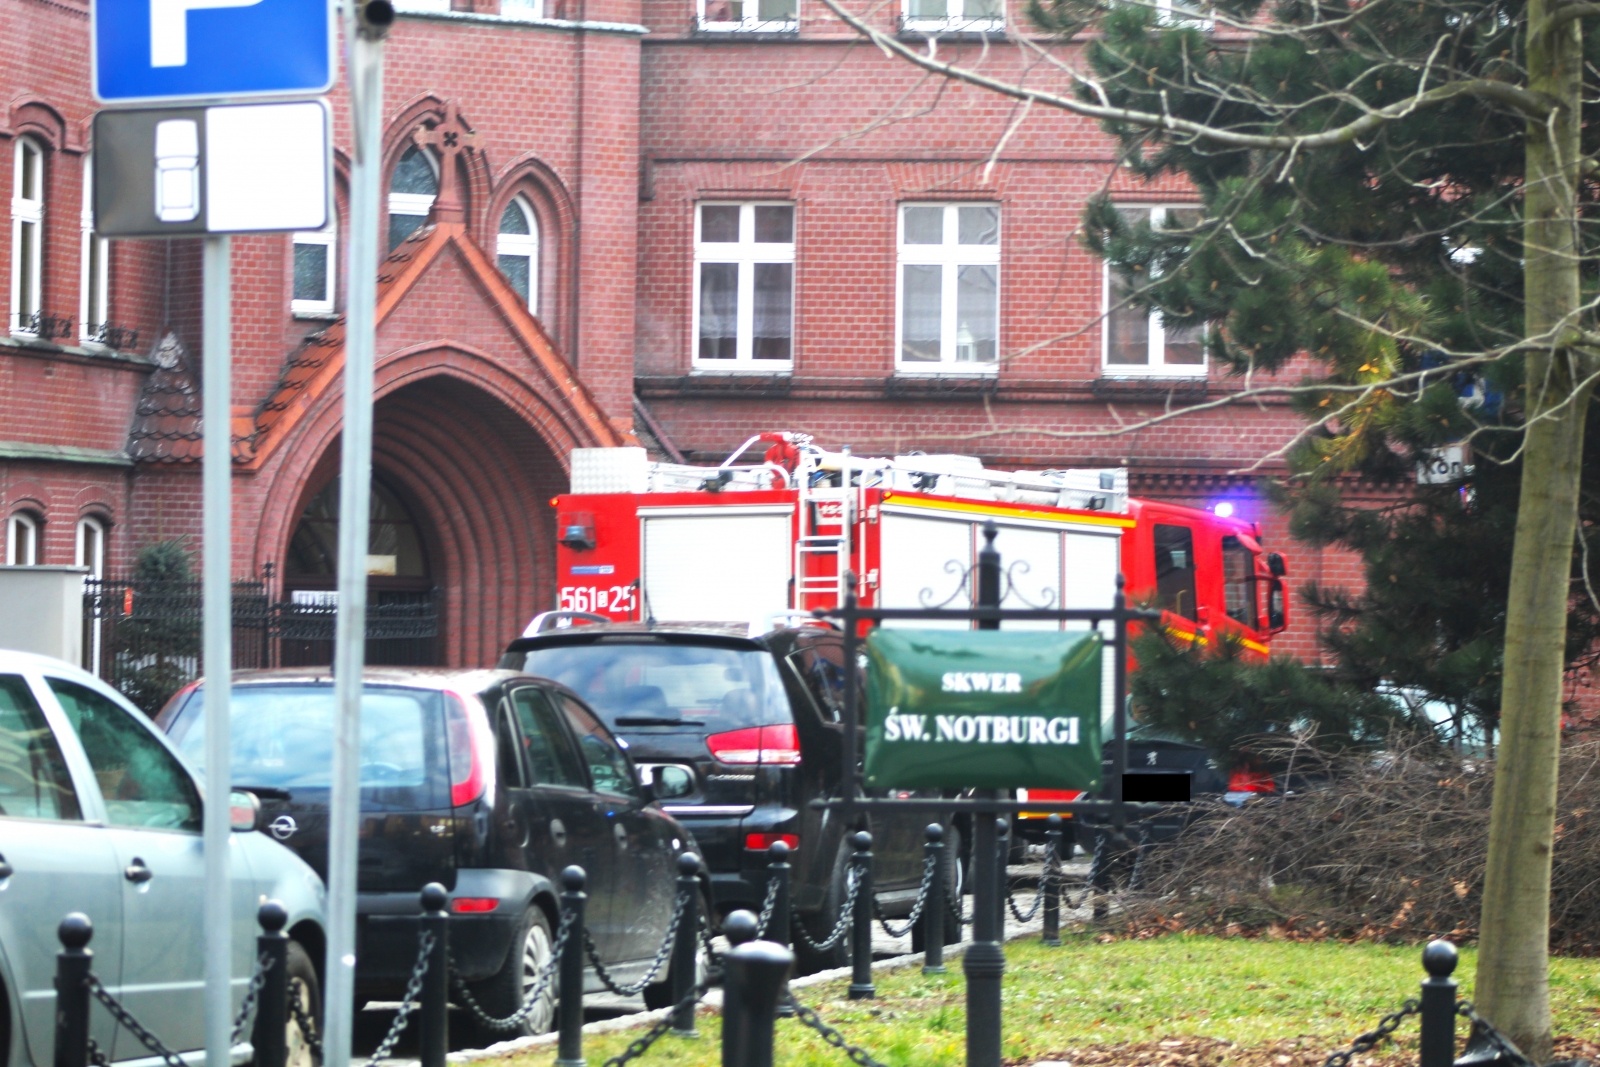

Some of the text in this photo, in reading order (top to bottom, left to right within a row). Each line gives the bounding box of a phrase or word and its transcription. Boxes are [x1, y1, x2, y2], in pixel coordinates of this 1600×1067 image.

[942, 672, 1022, 692] SKWER
[884, 706, 1079, 744] ŚW. NOTBURGI
